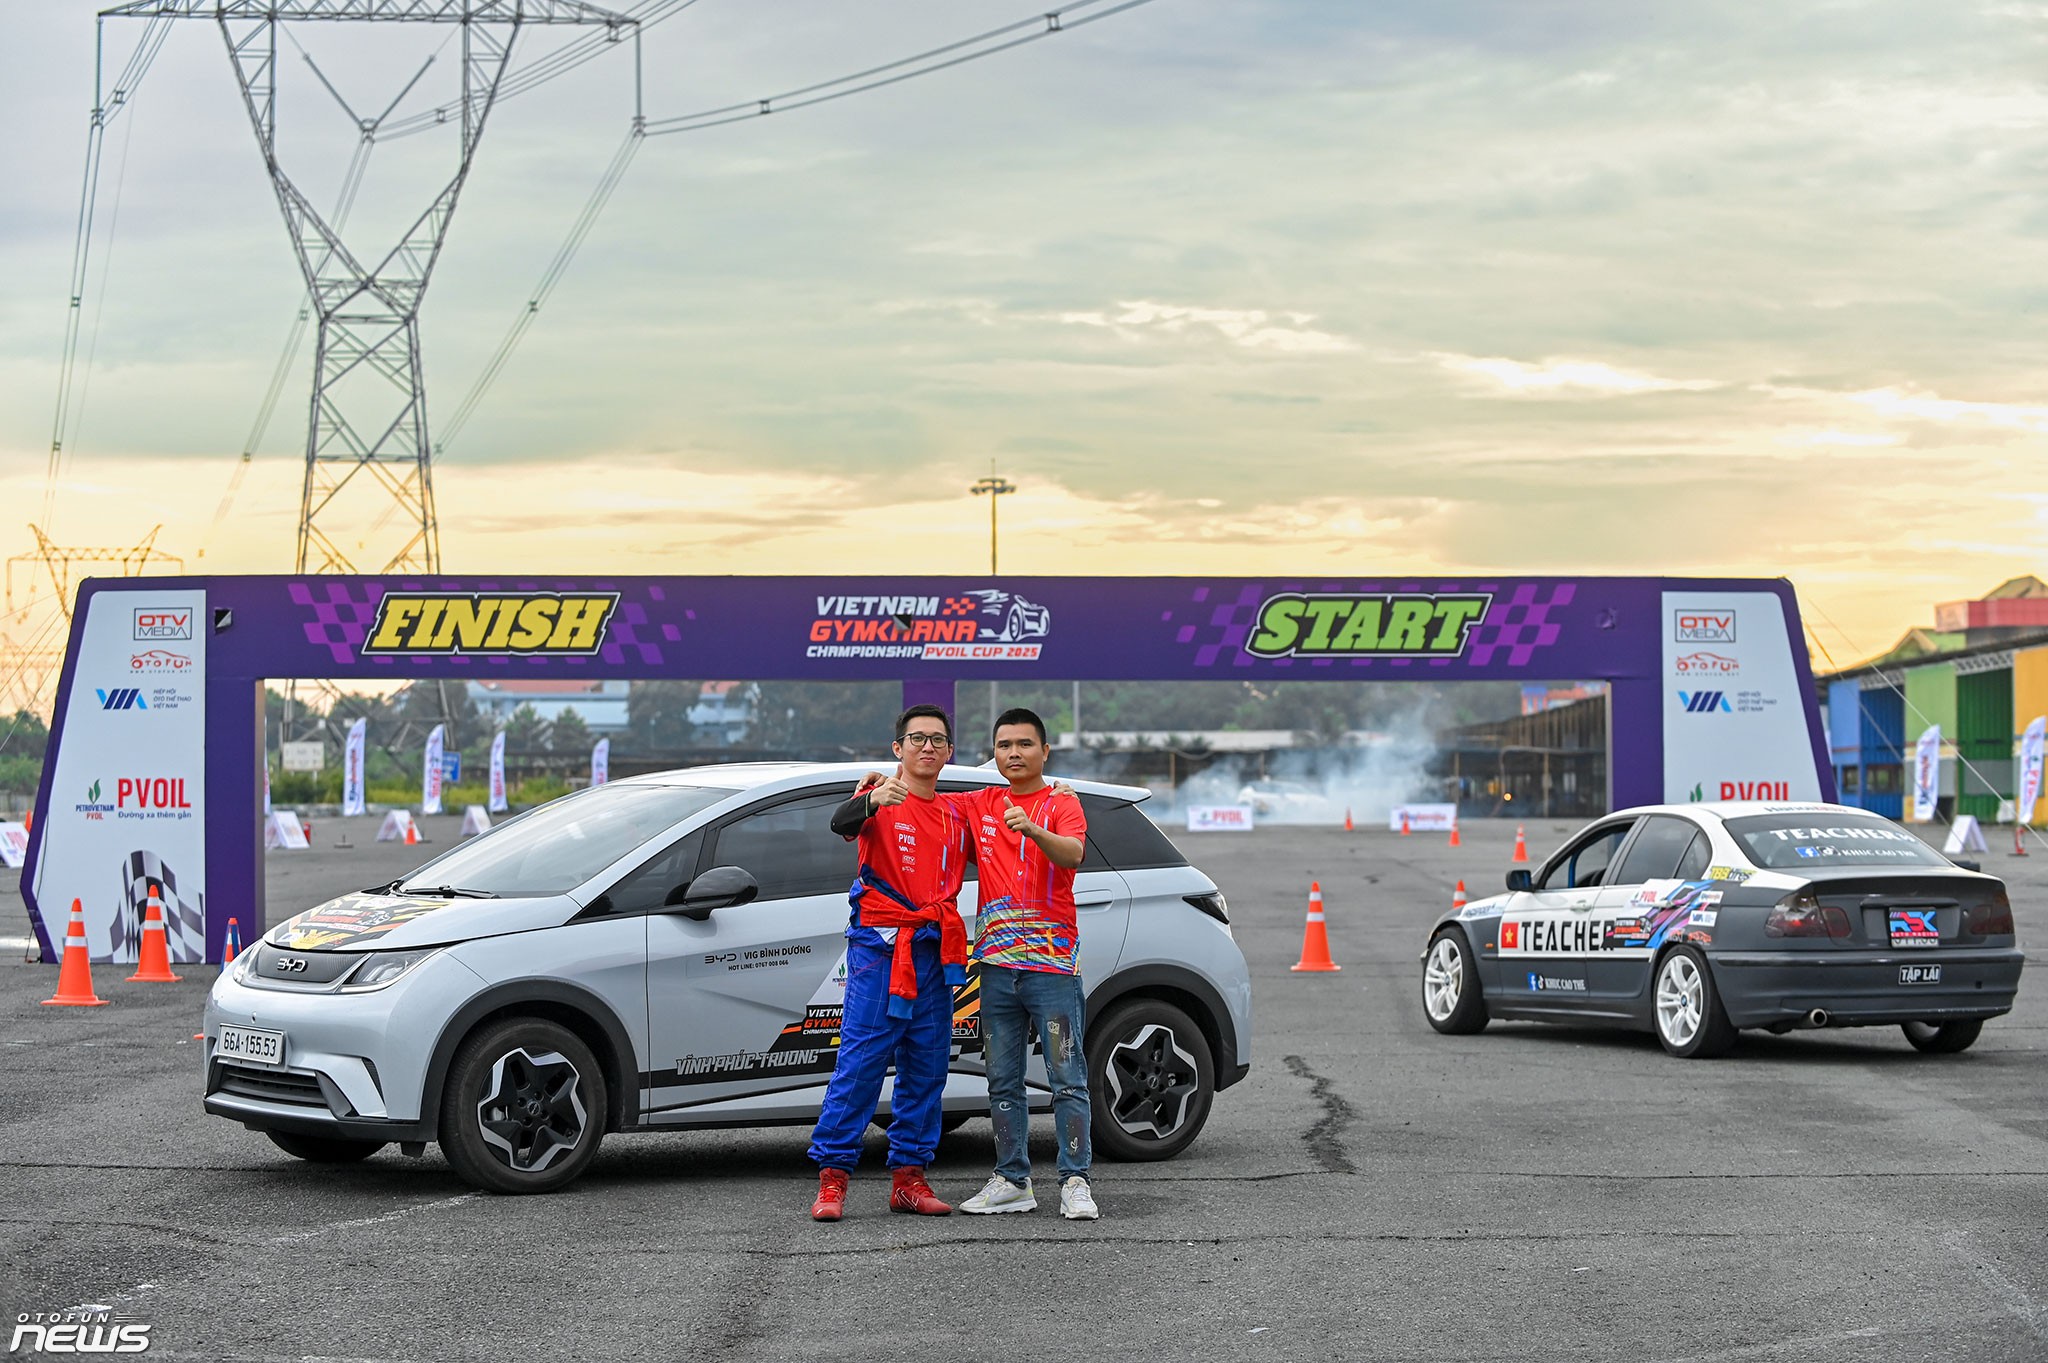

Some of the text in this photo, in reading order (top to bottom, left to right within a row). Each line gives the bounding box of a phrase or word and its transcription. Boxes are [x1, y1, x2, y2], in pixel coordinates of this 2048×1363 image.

[817, 596, 940, 616] VIETNAM
[139, 614, 188, 626] OTV
[371, 599, 611, 649] FINISH
[1254, 600, 1483, 651] START
[1680, 617, 1731, 629] OTV
[139, 627, 188, 639] MEDIA
[1680, 628, 1733, 642] MEDIA
[806, 646, 1038, 658] CHAMPIONSHIP PVOIL CUP 2025
[118, 778, 191, 808] PVOIL
[86, 812, 104, 820] PVOIL
[898, 833, 916, 846] PVOIL
[1769, 827, 1904, 842] TEACHER
[704, 953, 737, 964] BYD
[744, 950, 758, 960] VIG
[760, 947, 780, 958] BÌNH
[277, 958, 307, 972] BYD
[952, 1028, 976, 1036] EDIA
